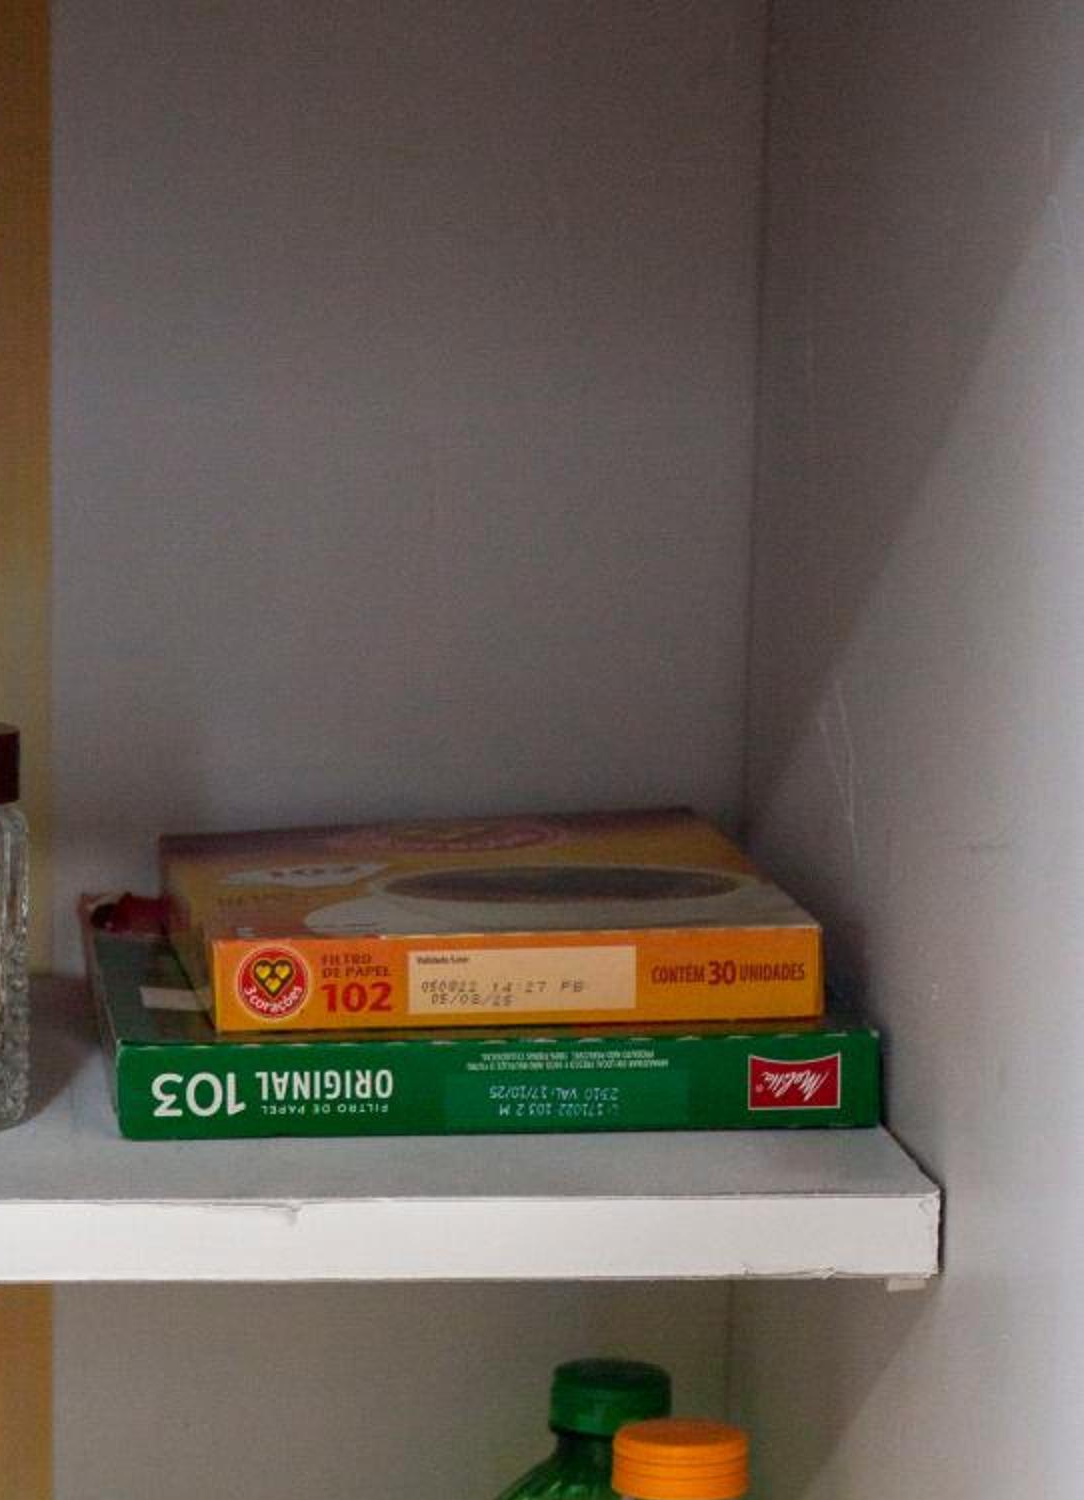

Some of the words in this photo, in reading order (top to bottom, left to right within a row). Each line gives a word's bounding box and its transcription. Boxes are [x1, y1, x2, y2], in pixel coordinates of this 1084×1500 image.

[321, 952, 373, 966] FILTRO
[322, 967, 341, 979] DE
[345, 965, 392, 978] PAPEL
[651, 962, 706, 984] CONTÉM
[707, 959, 738, 987] 30
[740, 962, 806, 982] UNIDADES
[320, 981, 393, 1013] 102
[150, 1071, 247, 1118] 103
[255, 1068, 394, 1101] ORIGINAL
[760, 1070, 829, 1102] Melitta
[259, 1104, 305, 1116] PAPEL
[312, 1103, 331, 1115] DE
[336, 1102, 389, 1114] FILTRO
